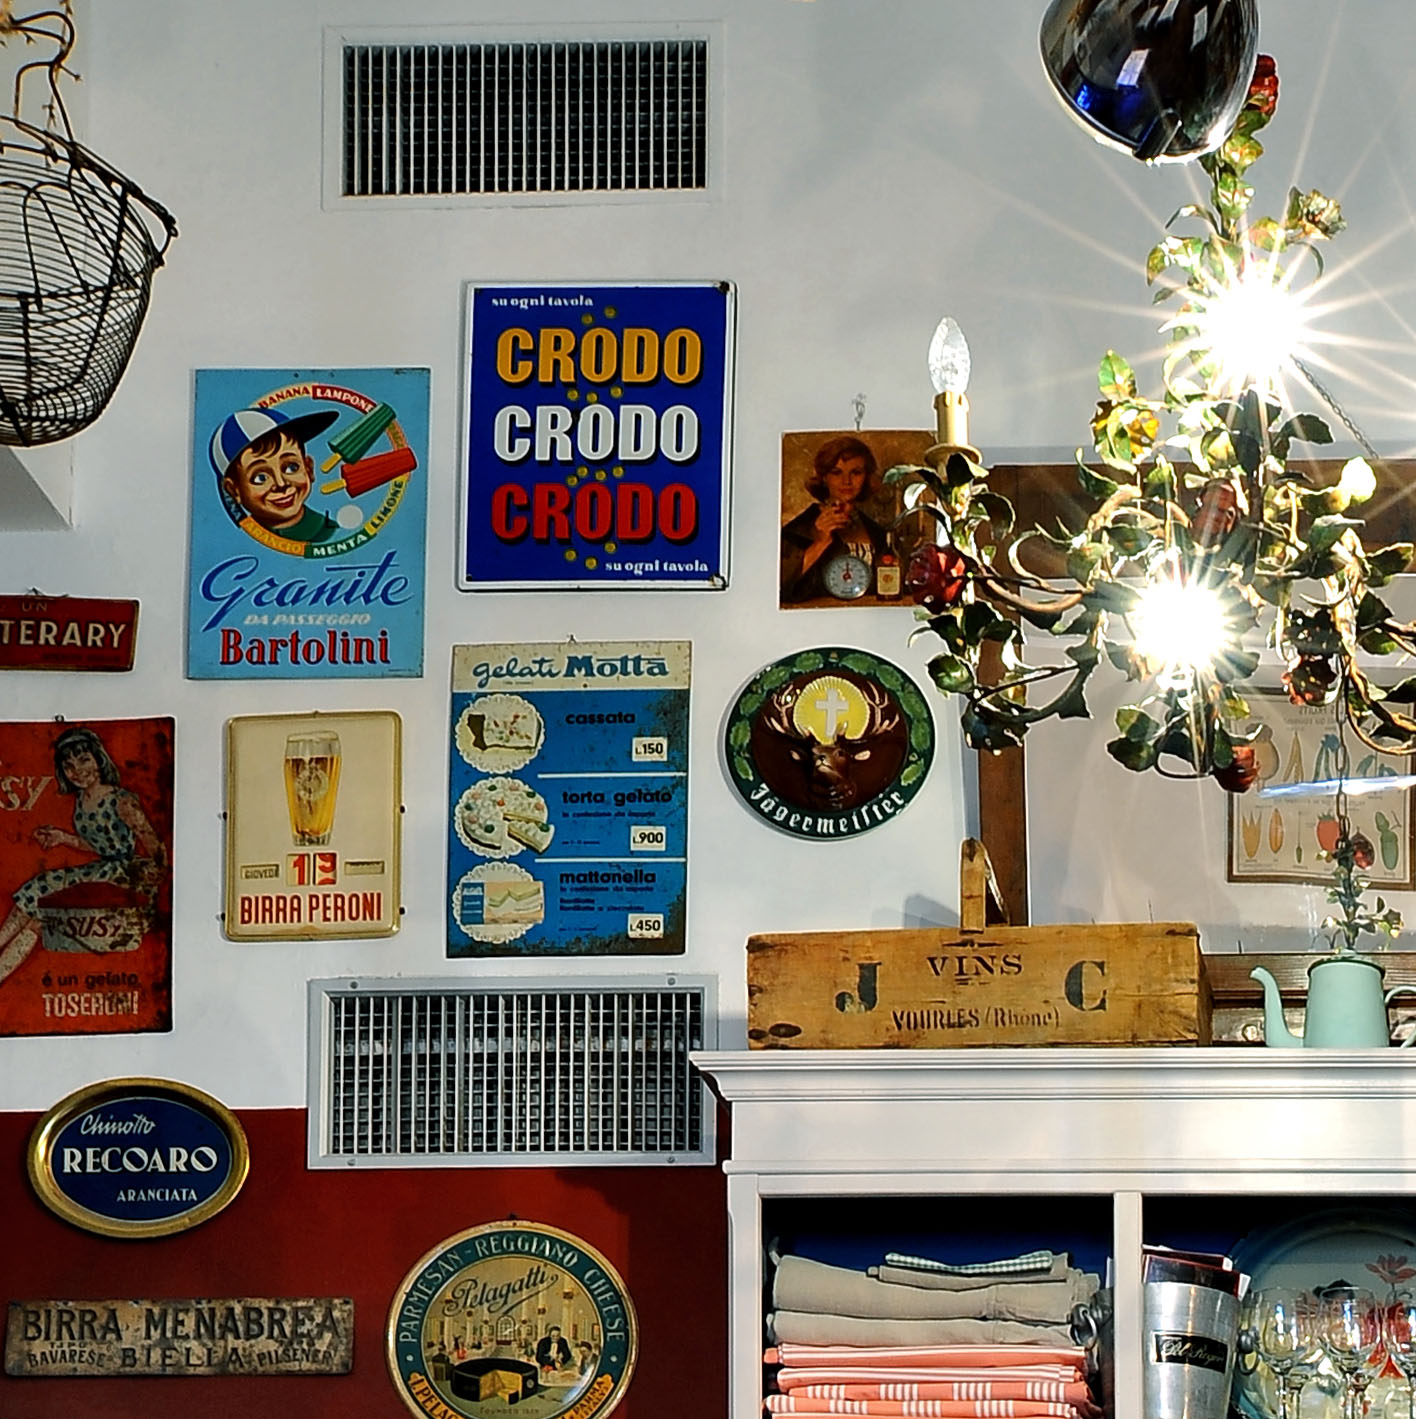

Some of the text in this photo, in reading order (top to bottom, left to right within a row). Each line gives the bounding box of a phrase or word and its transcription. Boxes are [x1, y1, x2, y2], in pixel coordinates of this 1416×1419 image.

[491, 295, 593, 309] su ogni tavola
[497, 328, 701, 383] CRODO
[494, 404, 698, 461] CRODO
[370, 480, 403, 528] LIMONE
[491, 482, 696, 540] CRODO
[313, 533, 367, 556] MENTA
[605, 560, 708, 575] su ogni tavola
[202, 551, 414, 632] Granite
[22, 602, 48, 612] UN
[243, 613, 371, 625] DA PASSEGGIO
[219, 628, 391, 666] Bartolini
[472, 654, 669, 688] gelati Motta
[565, 711, 636, 725] cassata
[562, 788, 672, 807] torta gelato
[559, 869, 657, 884] mattonella
[240, 892, 382, 925] BIRRA PERONI
[926, 953, 1024, 977] VINS
[57, 971, 139, 990] un gelato
[834, 960, 1108, 1014] J C
[80, 1113, 156, 1136] Chinotto
[62, 1146, 218, 1174] RECOARO
[116, 1188, 198, 1203] ARANCIATA
[400, 1236, 626, 1343] PARMESAN REGGIANO CHEESE
[442, 1262, 559, 1318] Pelagatti
[22, 1306, 340, 1342] BIRRA MENABREA
[27, 1349, 105, 1368] BAVARESE
[119, 1347, 244, 1369] BIELLA
